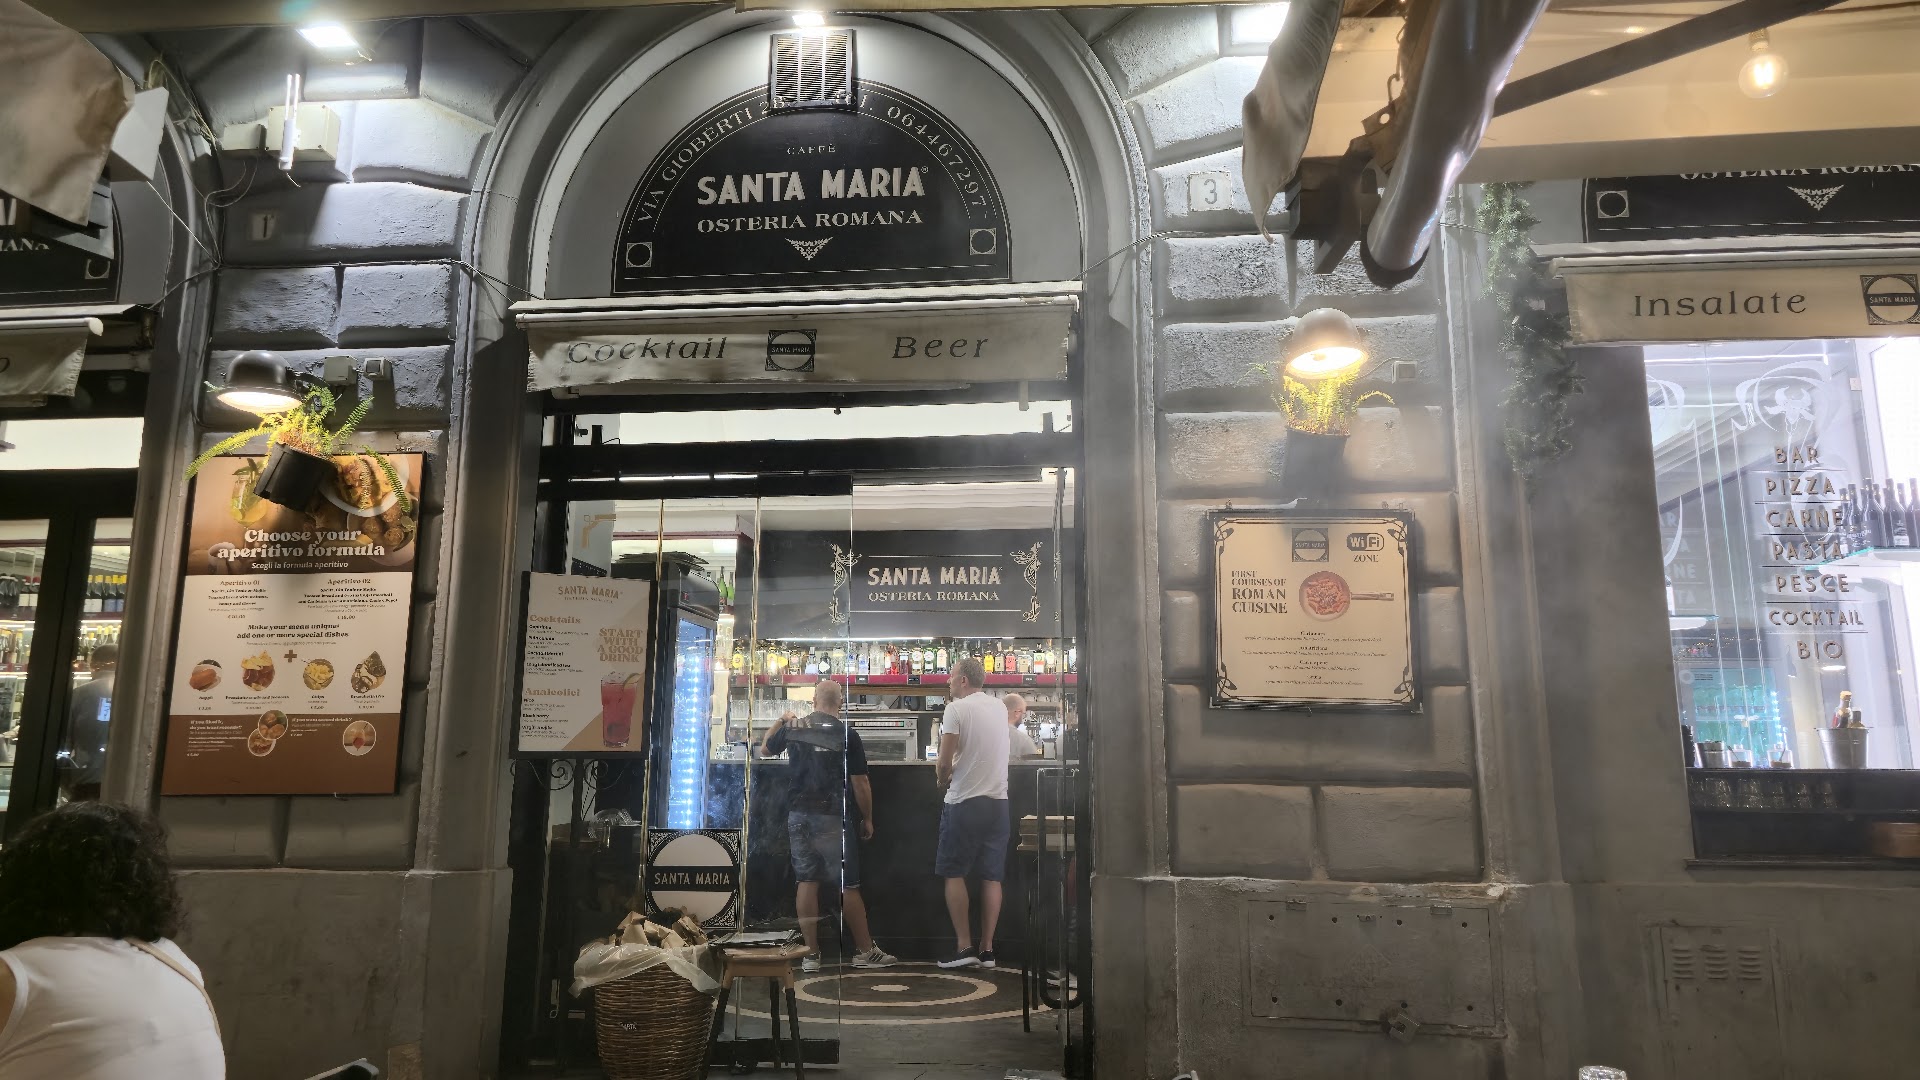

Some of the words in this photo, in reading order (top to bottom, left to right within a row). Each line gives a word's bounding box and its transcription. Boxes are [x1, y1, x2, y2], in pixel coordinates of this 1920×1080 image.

[637, 190, 665, 222] VIA
[662, 107, 753, 181] GIOBERTI
[697, 171, 806, 205] SANTA
[1203, 178, 1218, 205] 3
[697, 214, 804, 233] OSTERIA
[815, 209, 923, 228] ROMANA
[1634, 290, 1807, 317] Insalate
[1869, 296, 1892, 304] SANTA
[568, 336, 728, 364] Cocktail
[891, 336, 989, 359] Beer
[1775, 445, 1820, 464] BAR
[1765, 477, 1836, 496] PIZZA
[1766, 509, 1844, 528] CARNE
[244, 529, 311, 543] Choose
[314, 530, 362, 544] your
[217, 544, 303, 562] aperitivo
[307, 543, 385, 558] formula
[1353, 554, 1379, 562] ZONE
[1772, 541, 1845, 560] PASTA
[251, 561, 273, 570] Scegli
[274, 561, 282, 569] la
[283, 561, 313, 569] formula
[314, 561, 349, 570] aperitivo
[867, 567, 932, 586] SANTA
[1231, 570, 1258, 578] FIRST
[1231, 578, 1273, 586] COURSES
[1273, 578, 1287, 586] OF
[1775, 574, 1850, 593] PESCE
[558, 585, 588, 595] SANTA
[868, 591, 932, 602] OSTERIA
[936, 591, 1000, 601] ROMANA
[1231, 588, 1287, 600] ROMAN
[1231, 601, 1288, 614] CUISINE
[529, 614, 581, 624] Cocktails
[1768, 610, 1864, 626] COCKTAIL
[599, 627, 643, 638] START
[603, 637, 638, 646] WITH
[597, 645, 606, 653] A
[608, 645, 644, 655] GOOD
[1796, 640, 1844, 660] BIO
[599, 653, 640, 663] DRINK
[654, 872, 690, 885] SANTA
[695, 872, 730, 885] MARIA
